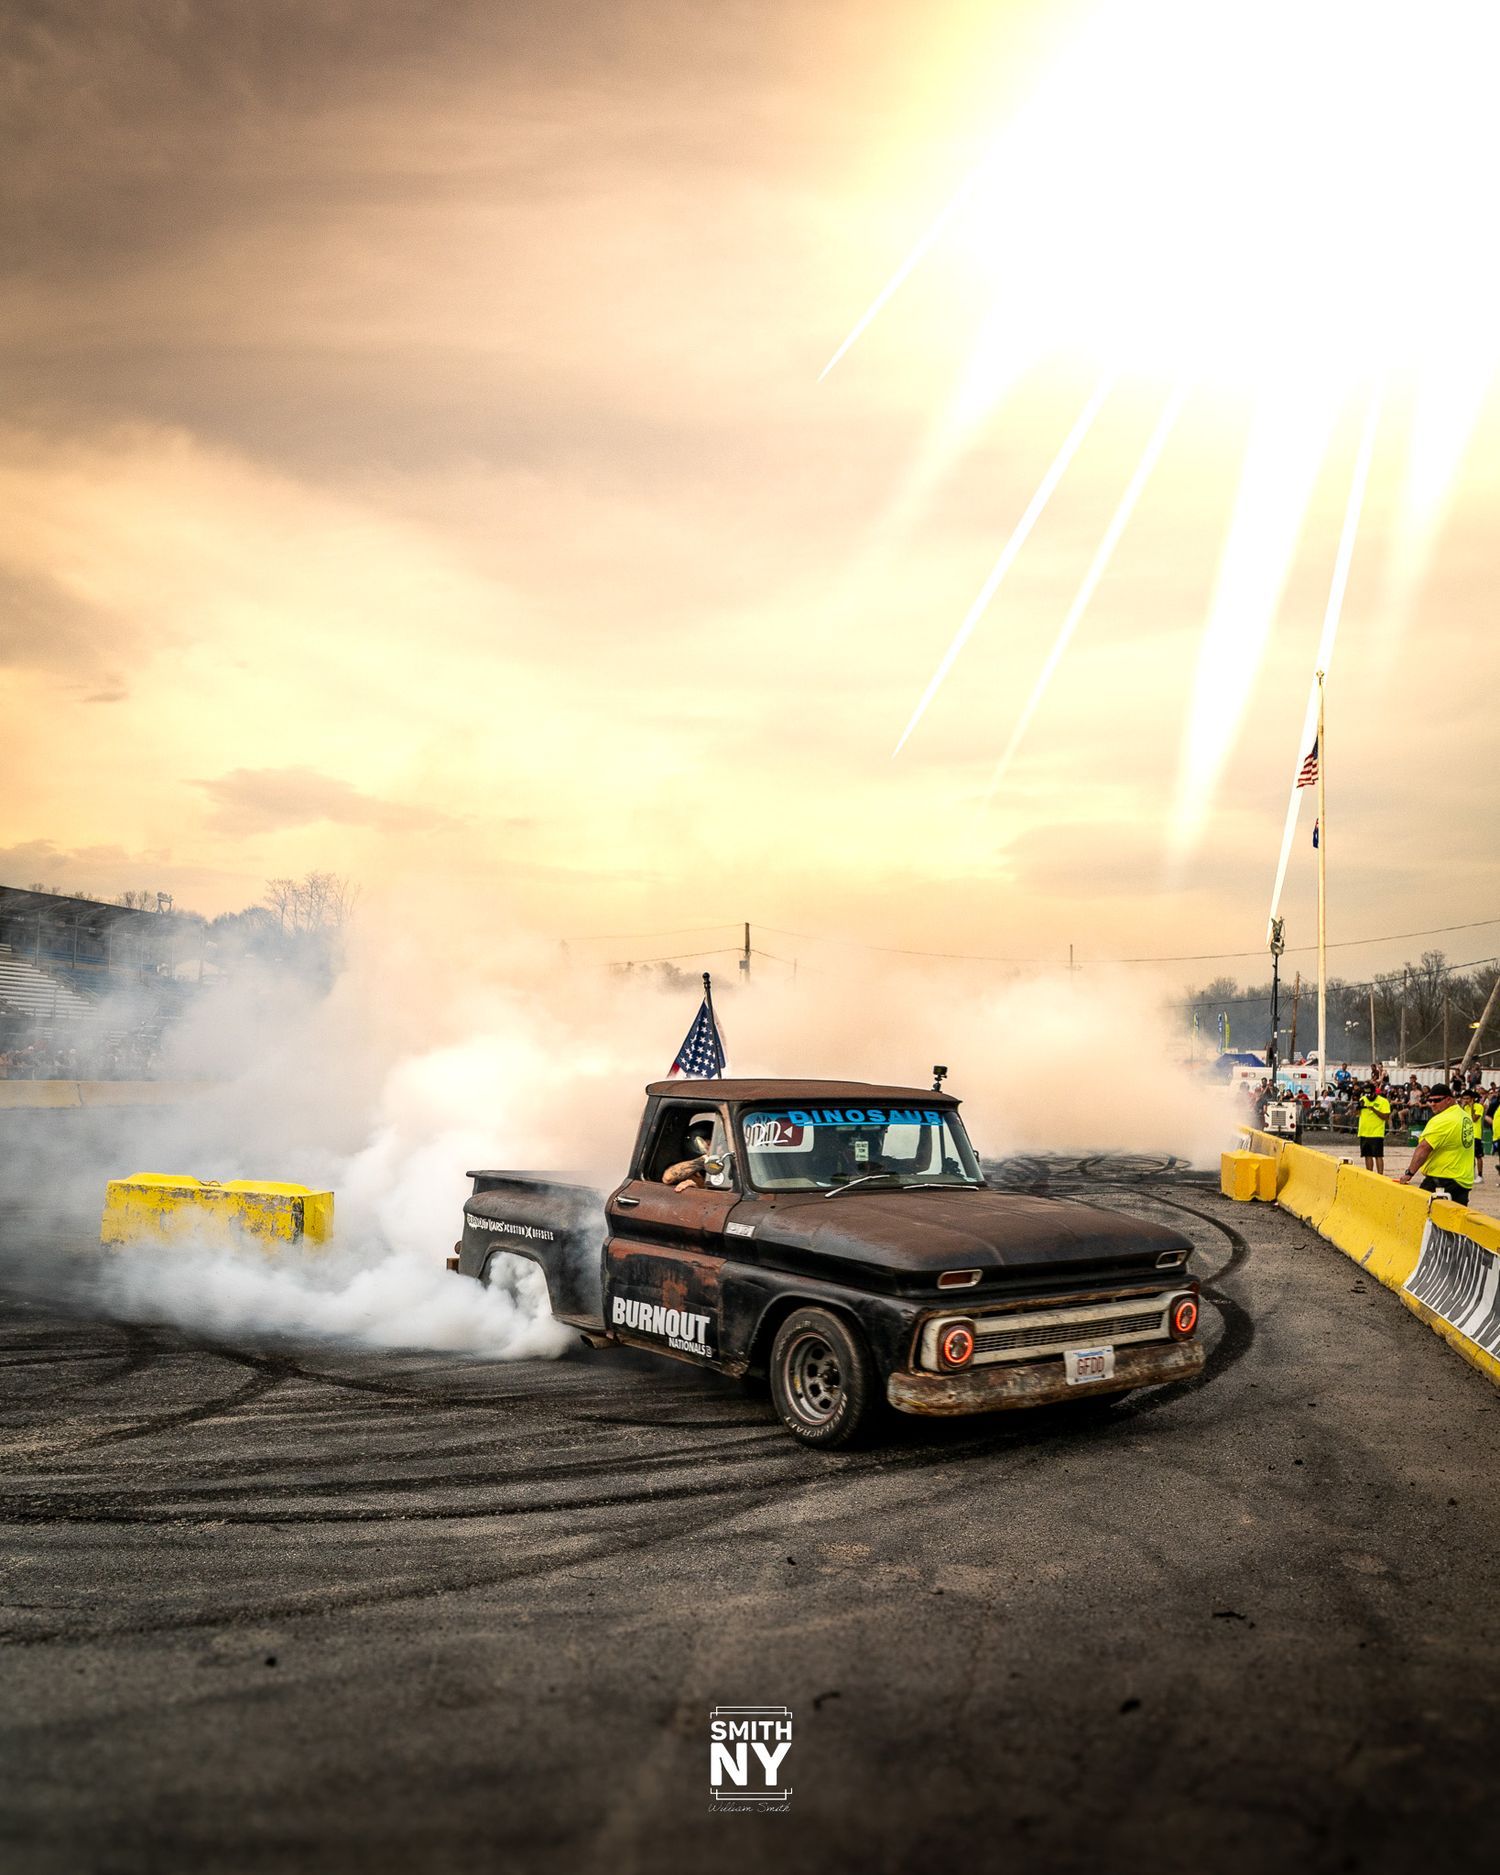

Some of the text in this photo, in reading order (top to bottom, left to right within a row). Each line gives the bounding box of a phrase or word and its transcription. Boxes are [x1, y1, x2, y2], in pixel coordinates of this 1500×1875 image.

[787, 1109, 942, 1125] DINOSAUR
[612, 1296, 711, 1345] BURNOUT
[668, 1337, 706, 1355] NATIONALS
